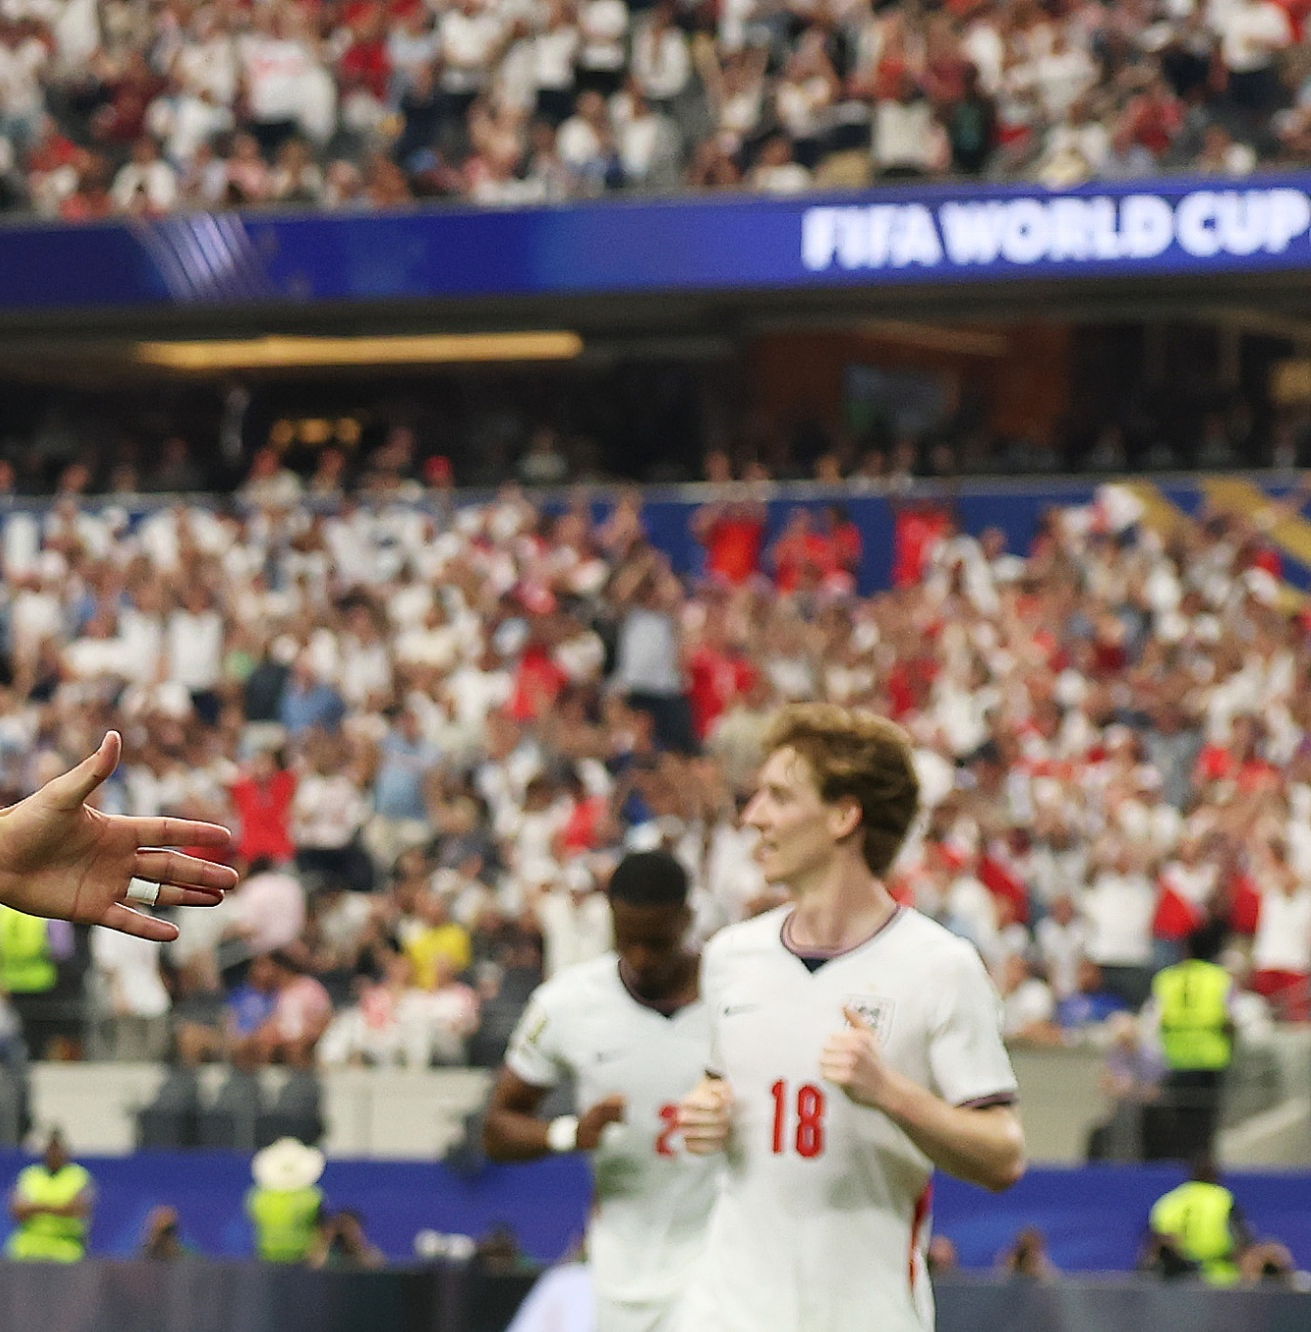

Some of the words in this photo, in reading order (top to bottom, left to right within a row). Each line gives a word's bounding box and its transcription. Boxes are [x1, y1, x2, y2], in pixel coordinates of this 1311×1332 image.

[801, 203, 940, 271] FIFA
[939, 194, 1175, 265] WORLD
[1178, 188, 1310, 257] CUP
[771, 1079, 825, 1159] 18
